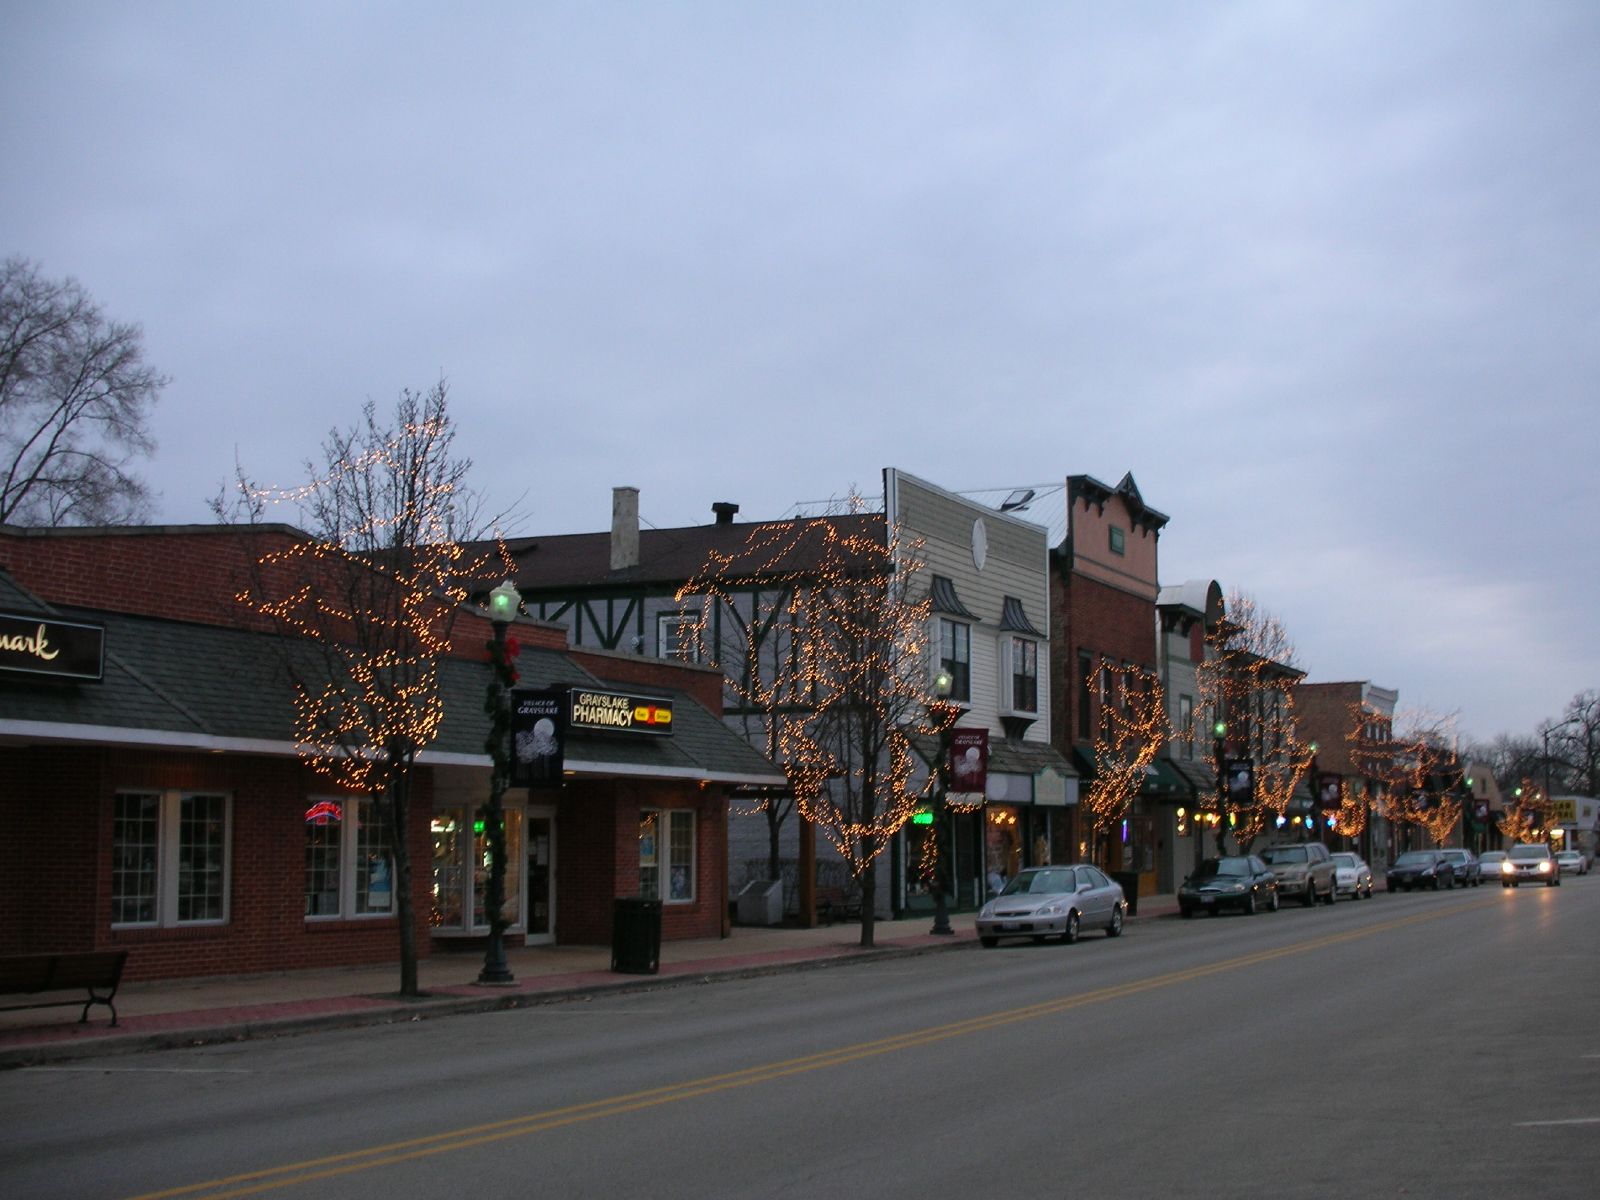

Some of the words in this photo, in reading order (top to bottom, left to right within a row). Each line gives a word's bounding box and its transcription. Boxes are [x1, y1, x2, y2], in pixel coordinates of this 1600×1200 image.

[517, 706, 558, 714] GRAYSLAKE
[579, 692, 630, 710] GRAYSLAKE
[573, 704, 634, 727] PHARMACY
